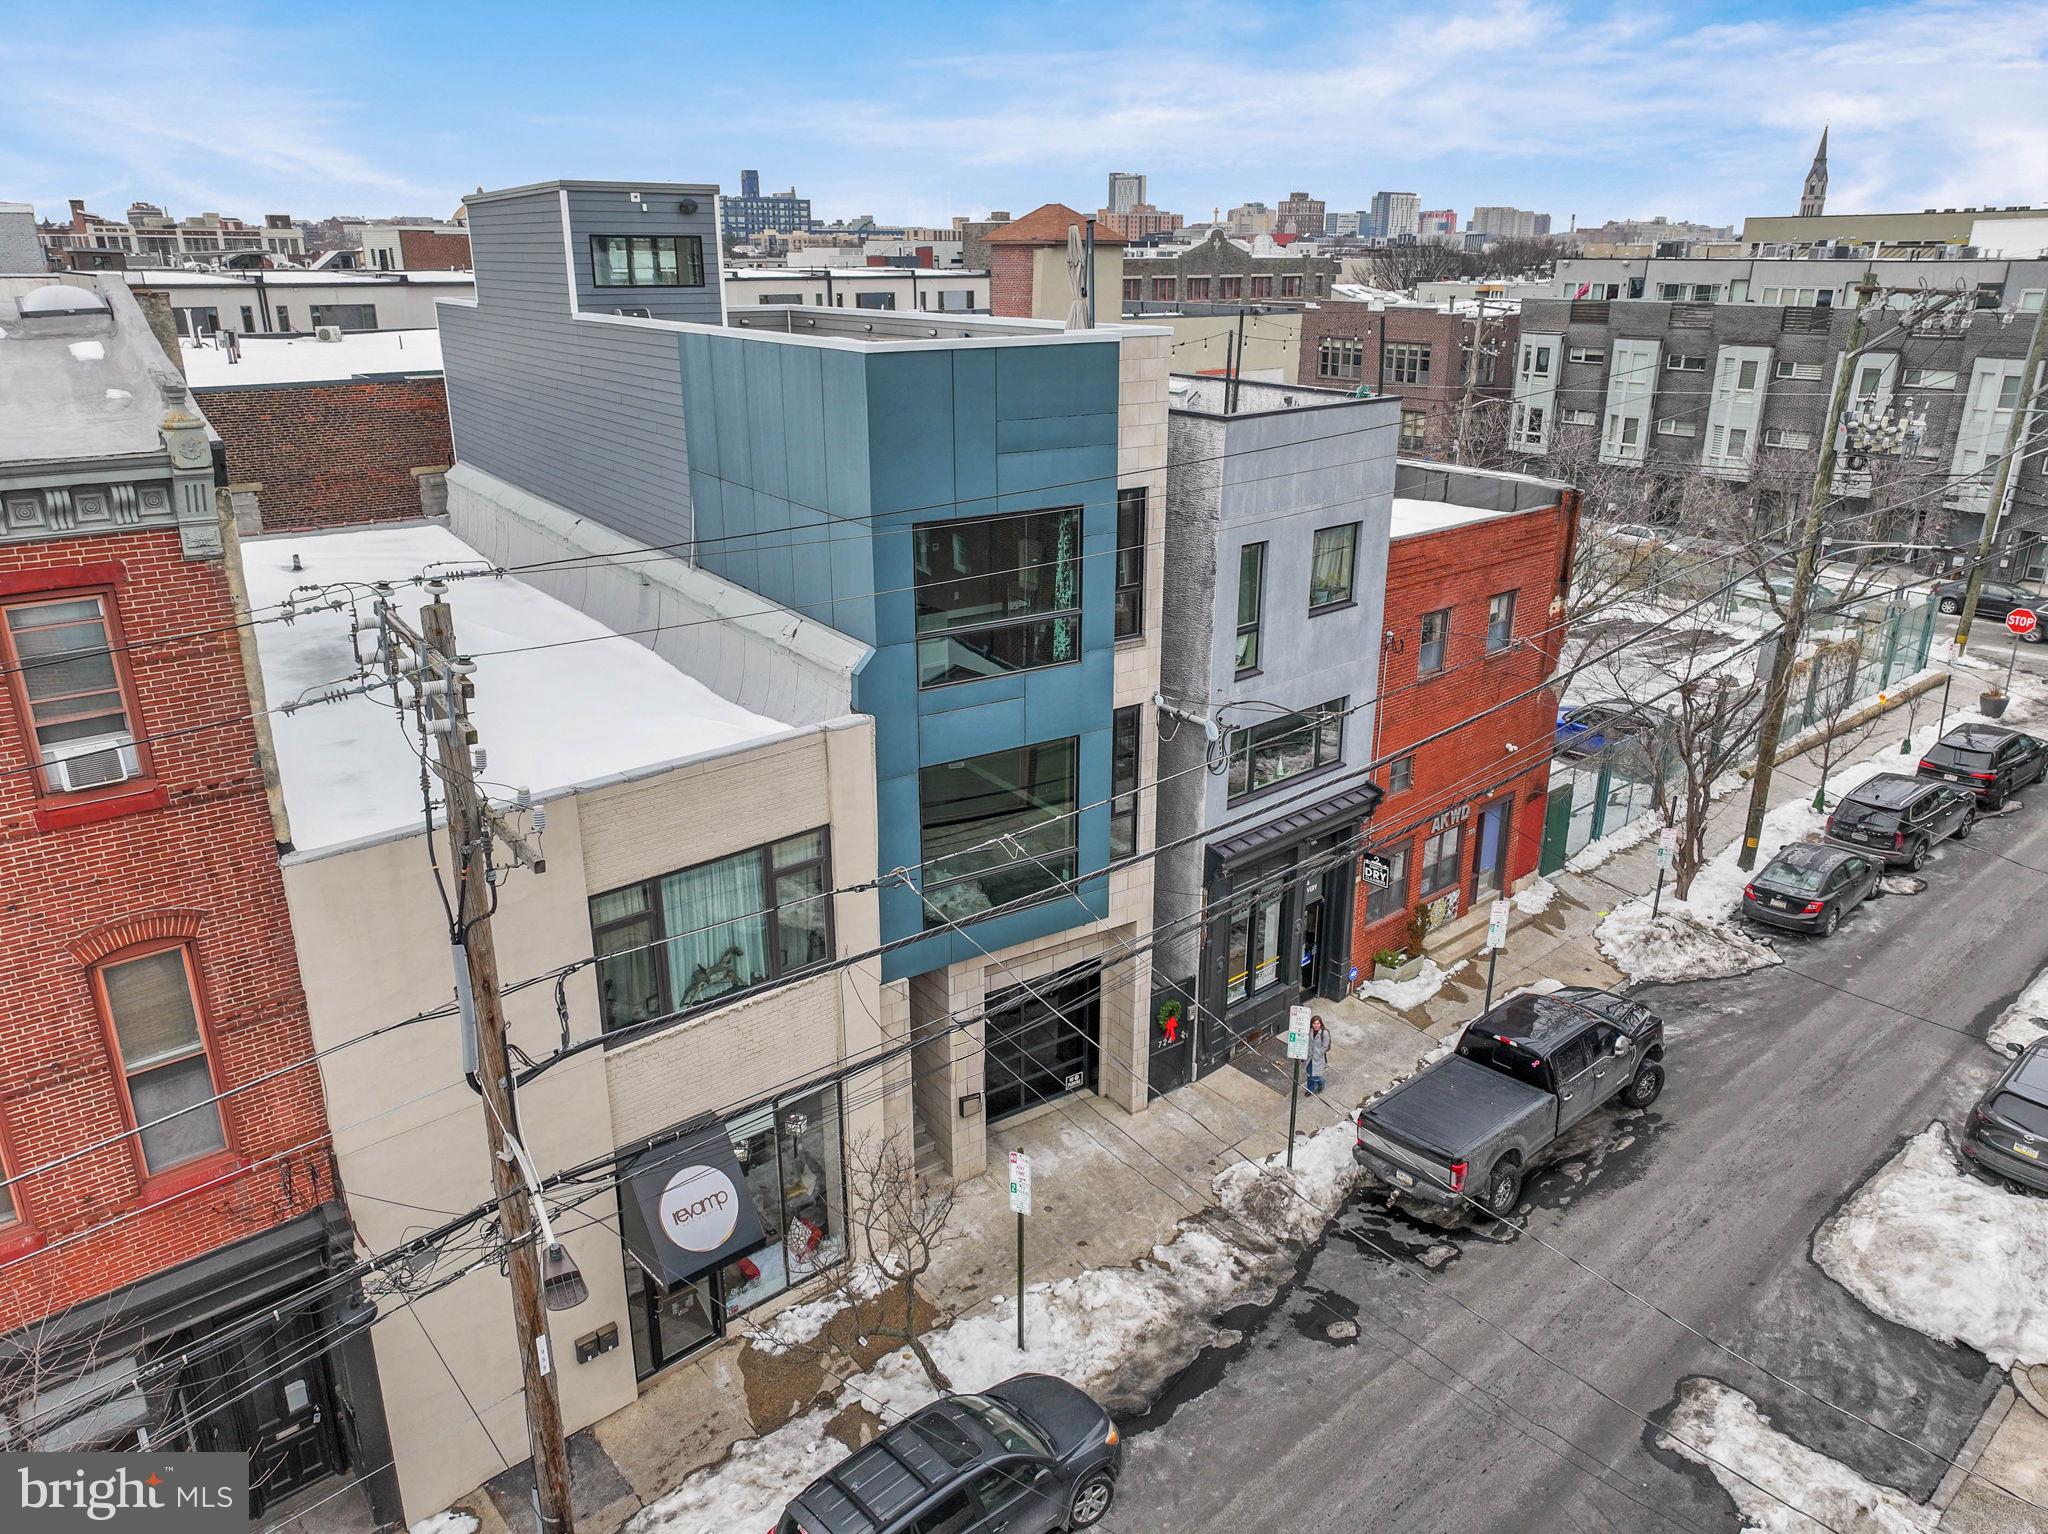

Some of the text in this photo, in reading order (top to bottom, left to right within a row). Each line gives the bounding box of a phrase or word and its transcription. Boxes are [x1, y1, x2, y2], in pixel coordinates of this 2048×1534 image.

[2008, 615, 2034, 627] STOP
[1431, 804, 1470, 833] AKWD
[1365, 867, 1387, 882] DRY
[672, 1190, 729, 1226] revamp
